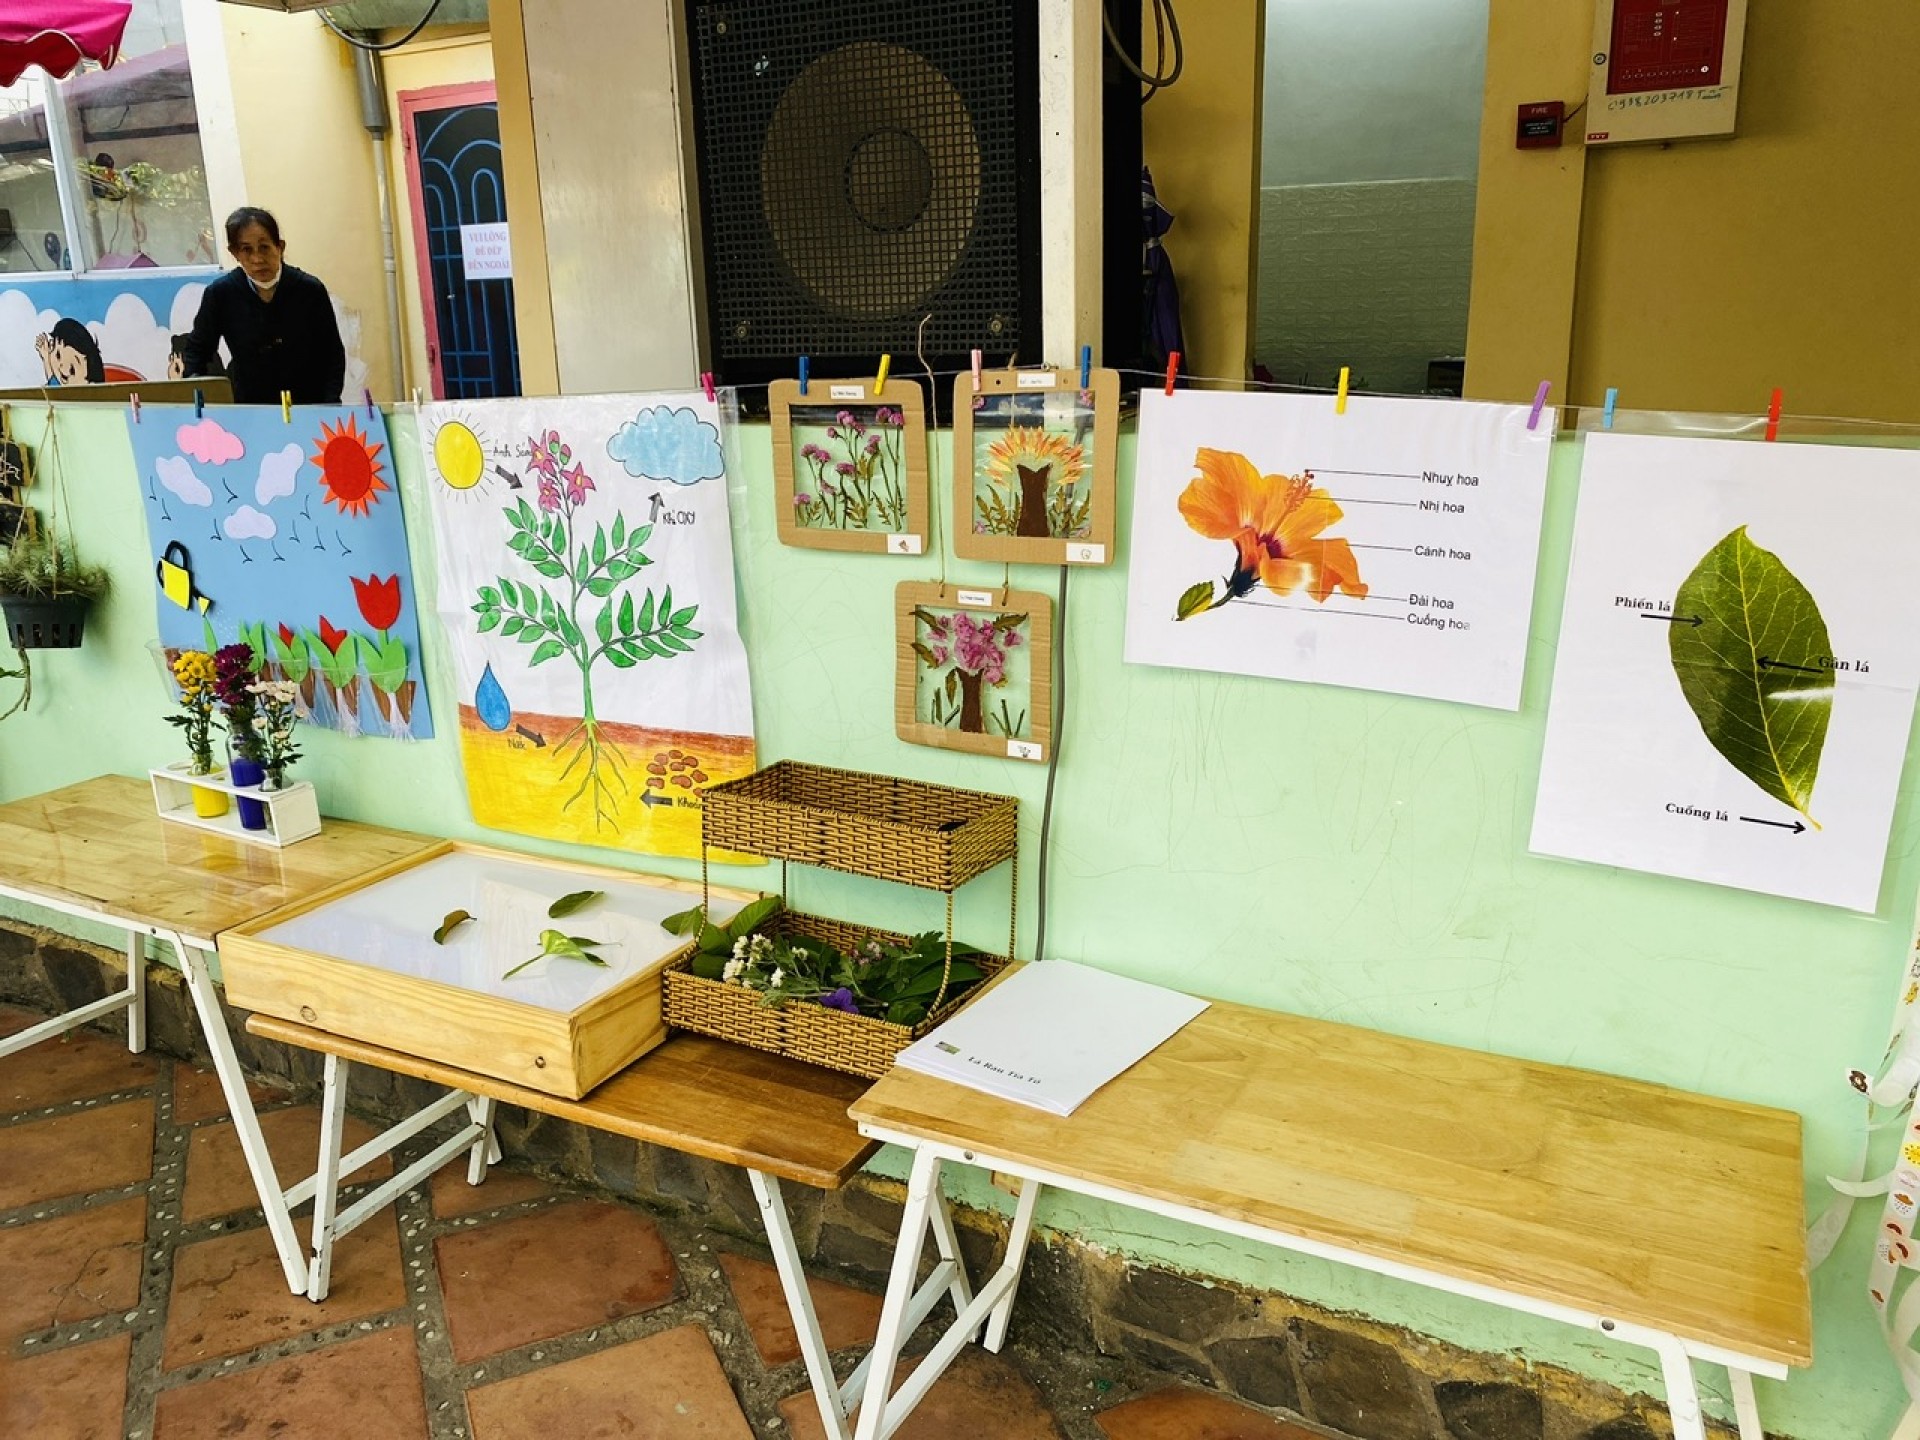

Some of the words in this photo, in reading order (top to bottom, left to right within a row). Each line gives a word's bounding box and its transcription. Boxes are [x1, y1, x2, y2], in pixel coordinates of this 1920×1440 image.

[1531, 106, 1549, 115] FIRE
[1456, 473, 1480, 487] hoa
[1419, 499, 1440, 514] Nhị
[1442, 501, 1465, 514] hoa
[1414, 545, 1447, 559] Cánh
[1448, 548, 1471, 560] hoa
[1431, 596, 1454, 610] hoa
[1614, 595, 1654, 610] Phiến
[1658, 600, 1671, 612] lá
[1406, 612, 1446, 631] Cuống
[1448, 617, 1471, 631] hoa
[1855, 659, 1870, 673] lá
[1665, 802, 1711, 821] Cuống
[1715, 809, 1729, 822] lá
